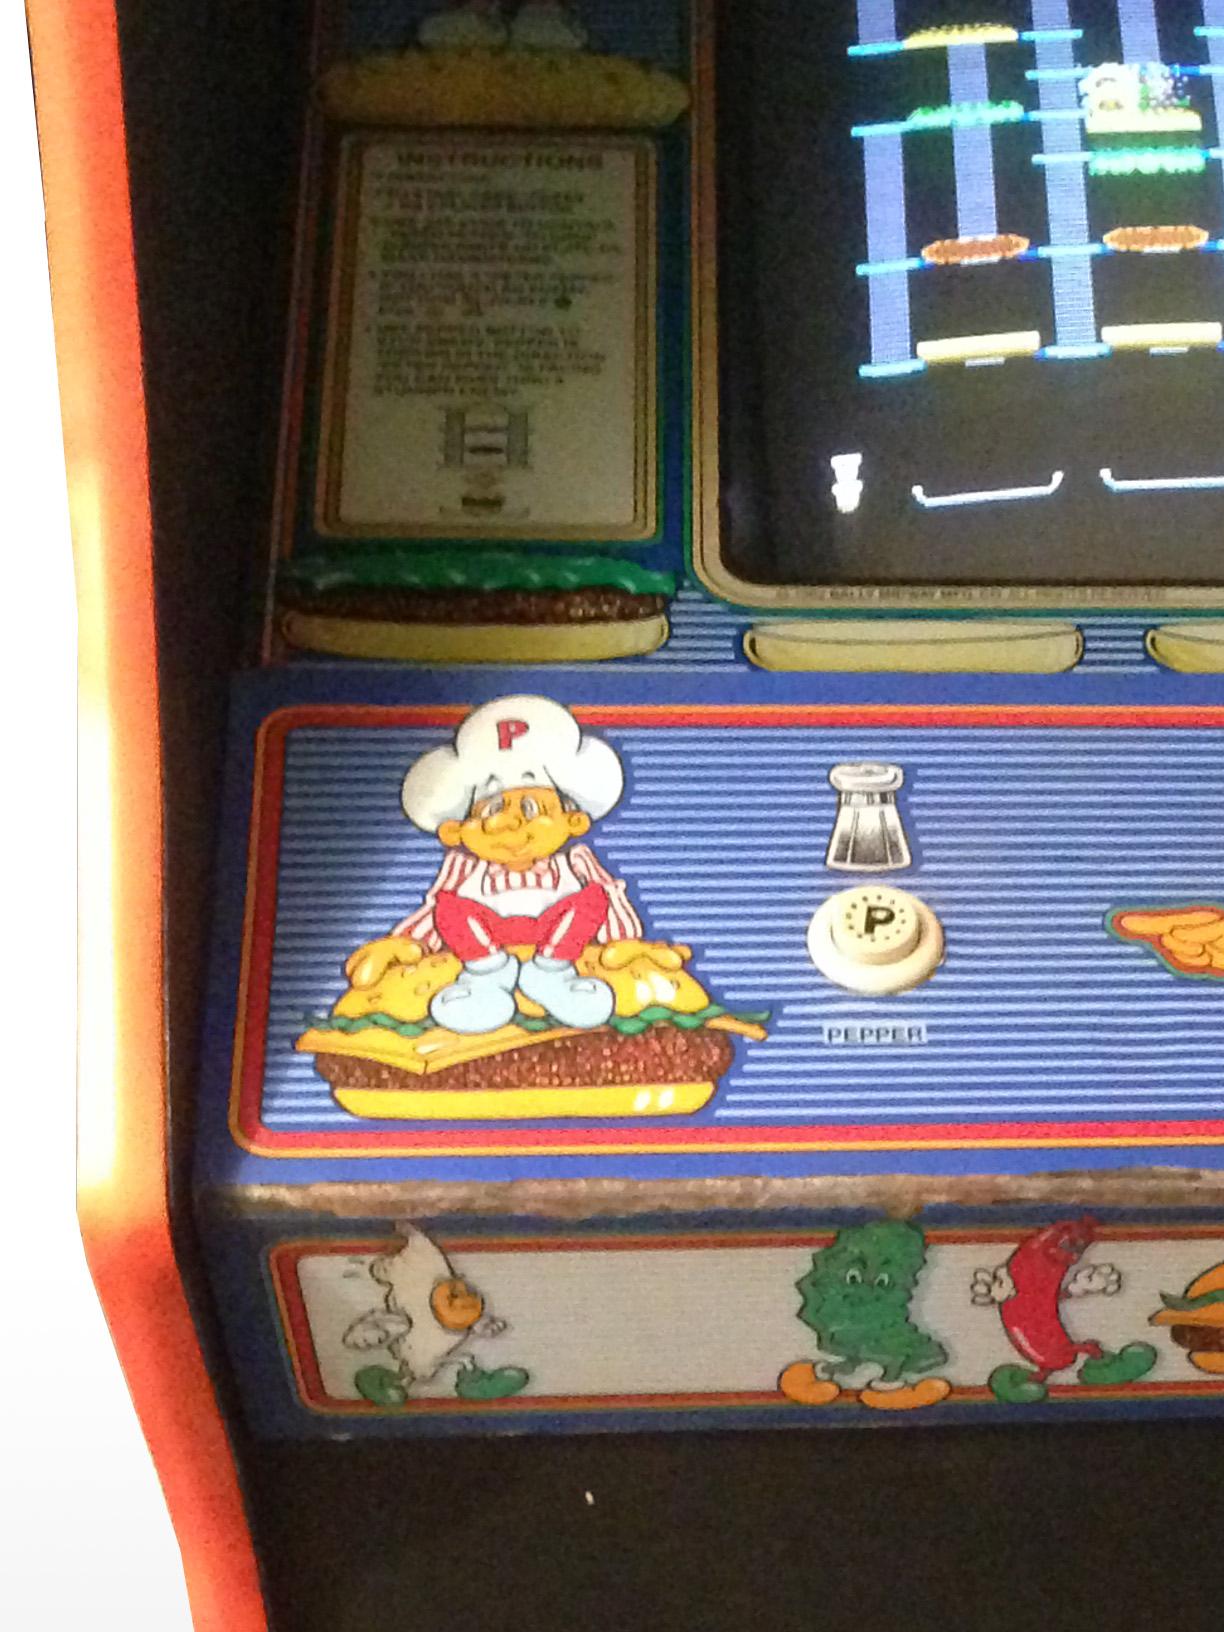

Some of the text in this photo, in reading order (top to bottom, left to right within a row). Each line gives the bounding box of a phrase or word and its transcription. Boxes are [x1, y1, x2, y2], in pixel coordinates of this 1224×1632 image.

[496, 719, 530, 750] P
[863, 905, 896, 935] P
[826, 1026, 923, 1043] PEPPER
